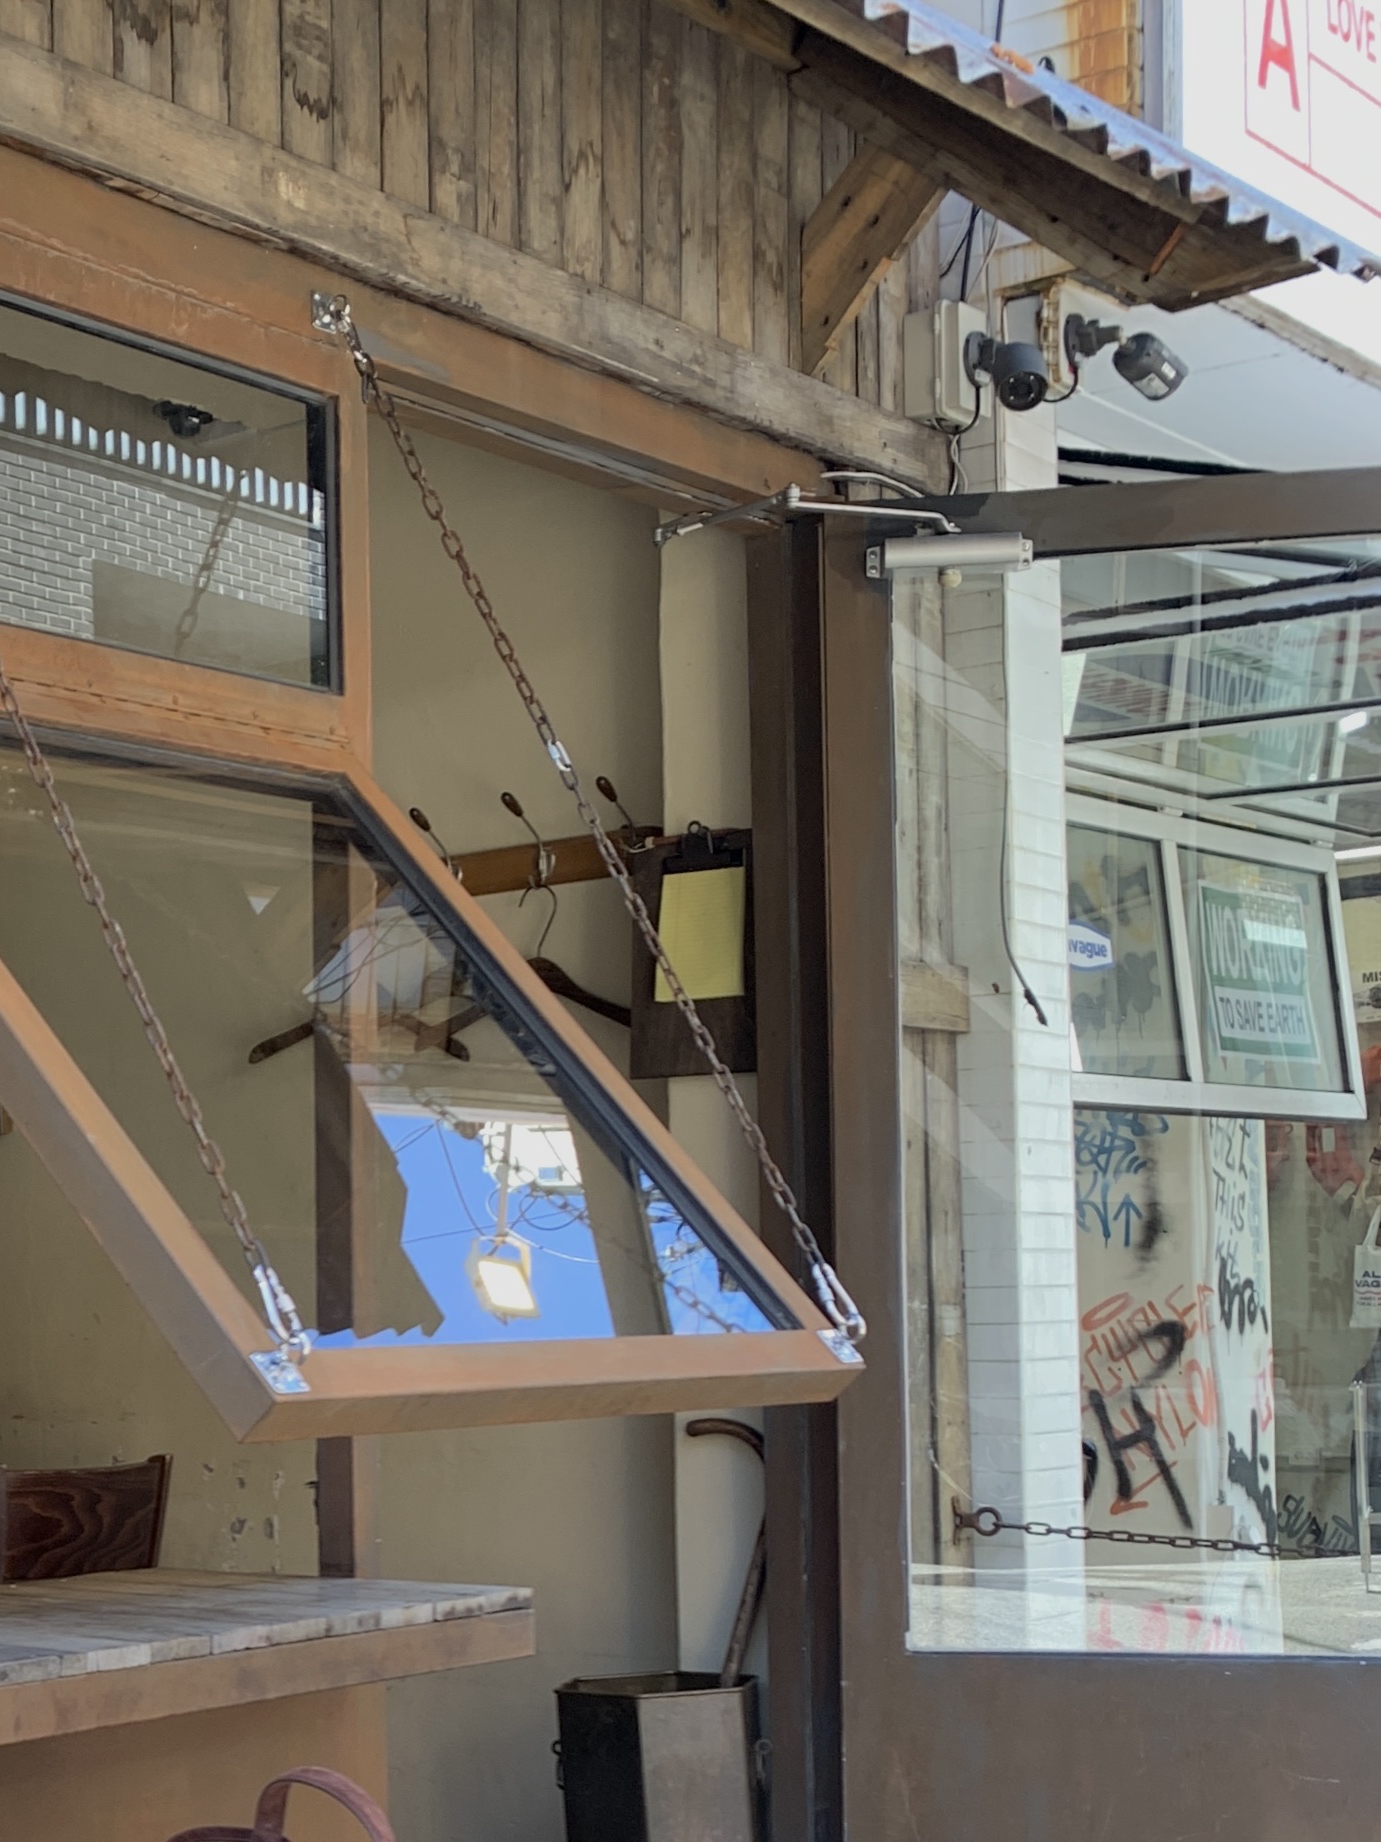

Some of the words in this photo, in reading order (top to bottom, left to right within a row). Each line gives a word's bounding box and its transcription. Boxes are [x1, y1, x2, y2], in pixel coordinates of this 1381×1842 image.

[1258, 0, 1301, 112] A
[1219, 996, 1235, 1029] TO
[1235, 998, 1265, 1033] SAVE
[1266, 1001, 1307, 1036] EARTH
